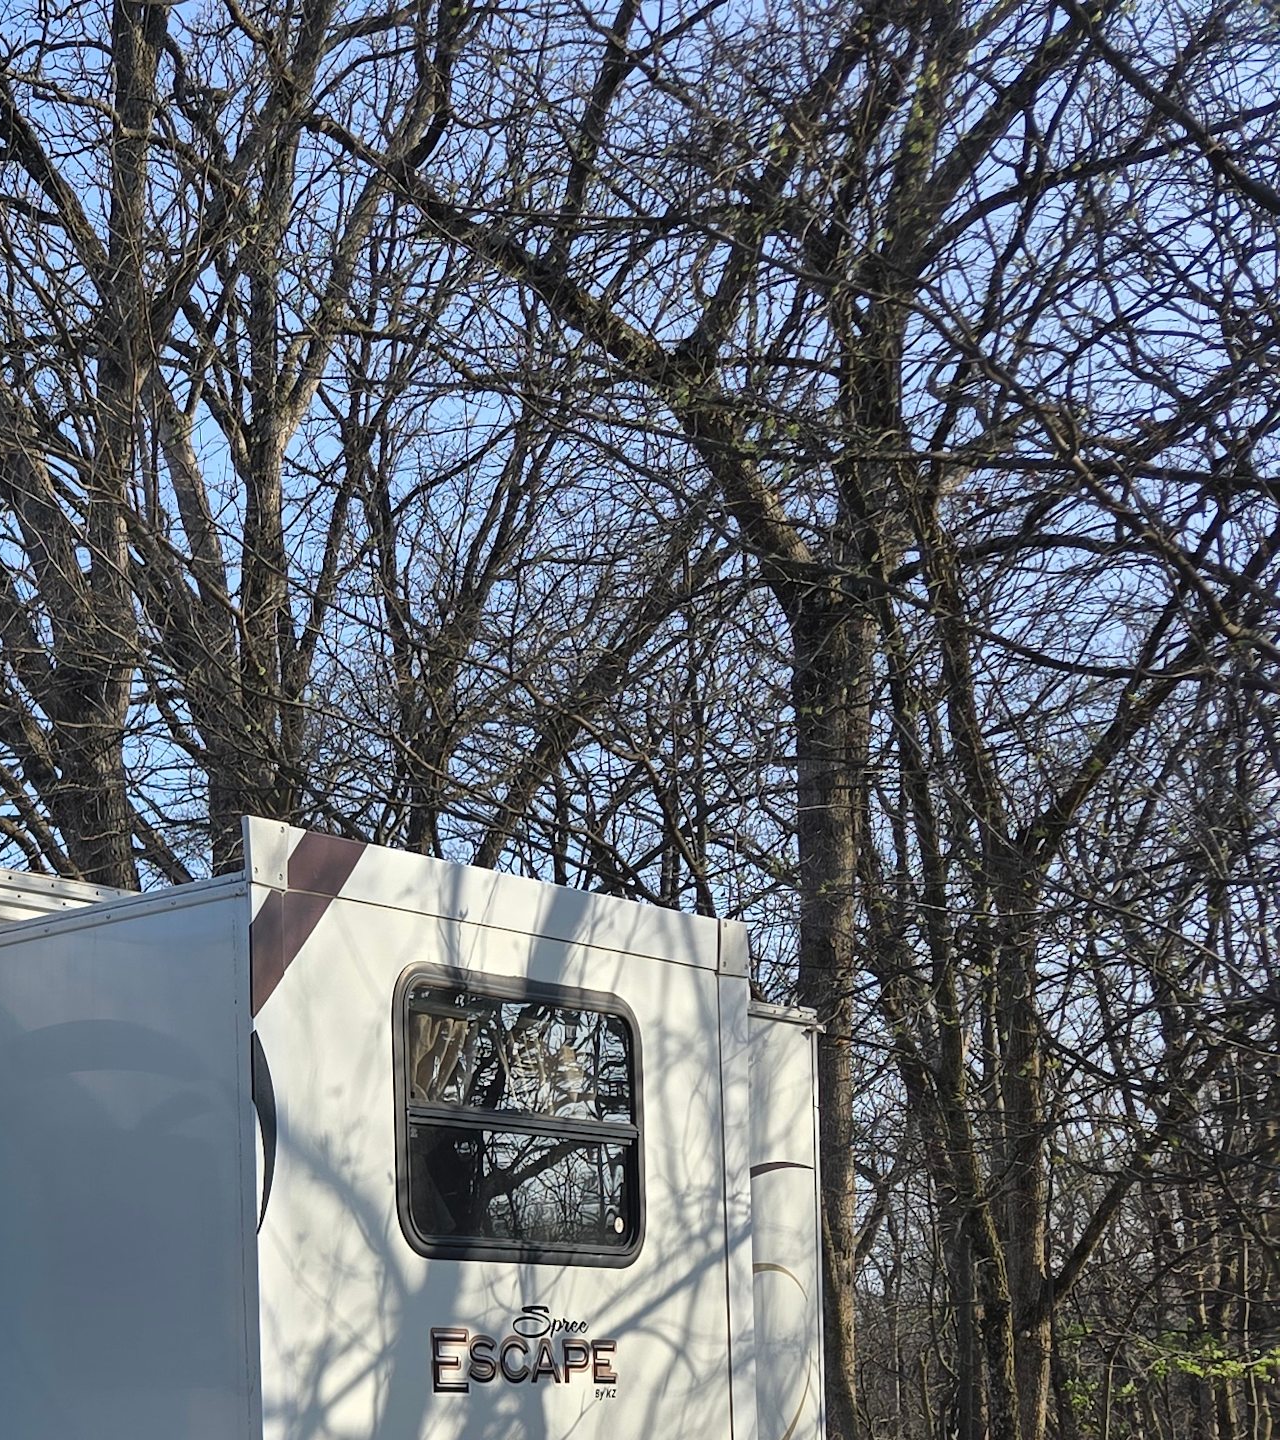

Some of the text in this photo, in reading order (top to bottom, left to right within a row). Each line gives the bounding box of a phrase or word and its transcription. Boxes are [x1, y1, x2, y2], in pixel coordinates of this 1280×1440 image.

[513, 1305, 589, 1338] Spree
[430, 1327, 618, 1394] ESCAPE
[595, 1388, 617, 1401] By KZ
